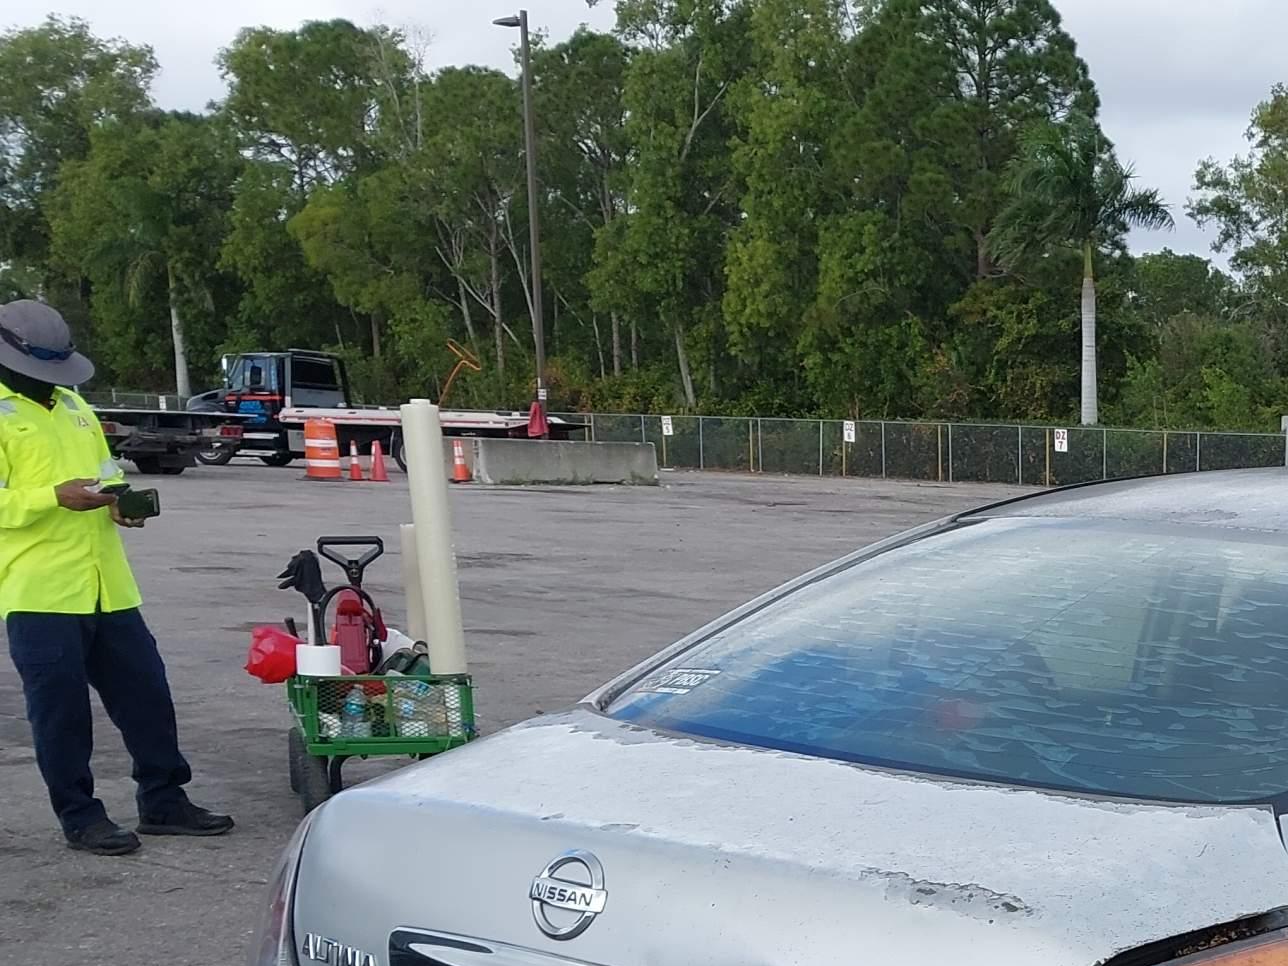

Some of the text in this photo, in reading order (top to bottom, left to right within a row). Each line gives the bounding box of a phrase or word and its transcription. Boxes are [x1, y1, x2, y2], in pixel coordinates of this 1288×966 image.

[1055, 431, 1066, 440] DZ
[1058, 441, 1063, 450] 7
[533, 883, 593, 906] NISSAN
